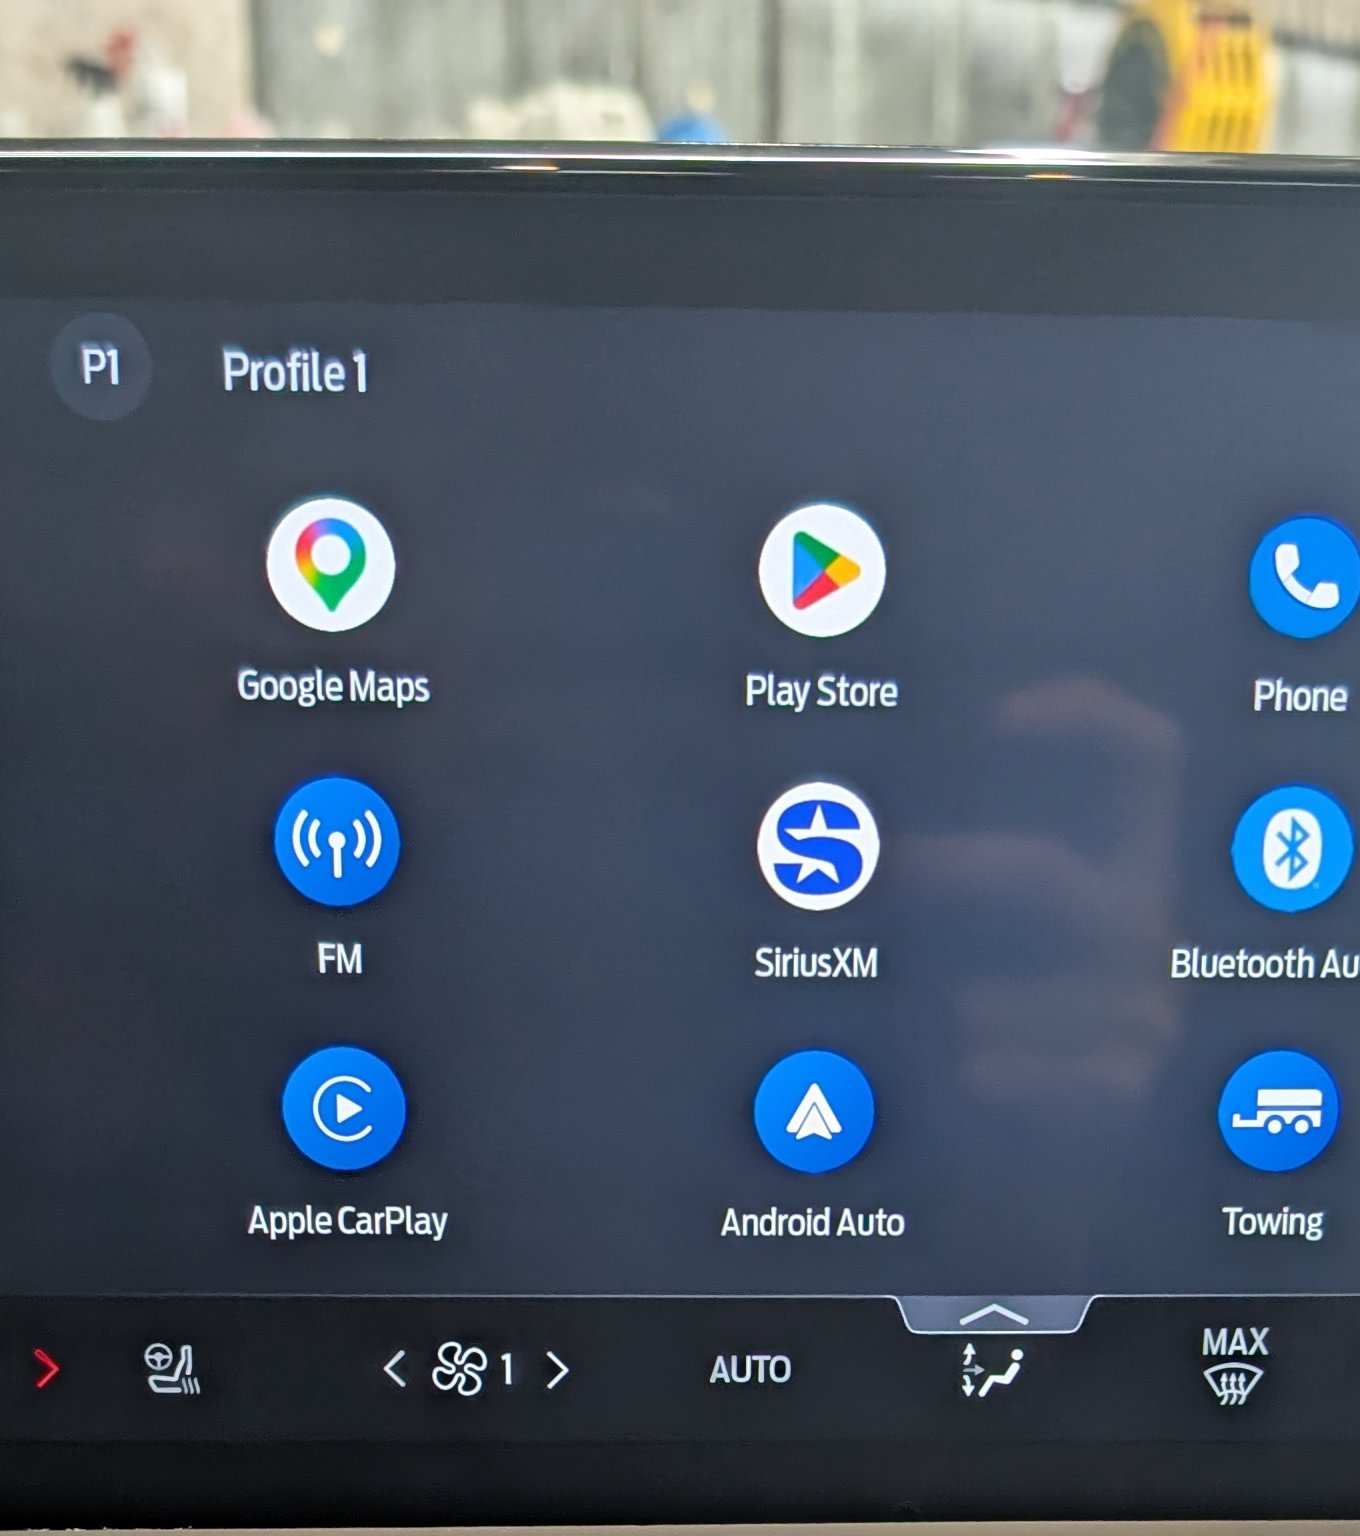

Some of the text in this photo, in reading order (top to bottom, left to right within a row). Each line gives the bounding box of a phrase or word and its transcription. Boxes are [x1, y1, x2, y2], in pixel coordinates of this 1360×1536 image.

[81, 344, 119, 385] P1
[223, 347, 368, 393] Profile 1
[237, 667, 431, 709] Google Maps
[746, 671, 899, 713] Play Store
[1254, 677, 1349, 712] Phone
[318, 941, 363, 974] FM
[754, 946, 878, 978] SiriusXM
[1170, 946, 1315, 979] Bluetooth
[247, 1204, 449, 1242] Apple CarPlay
[720, 1206, 906, 1237] Android Auto
[1221, 1206, 1325, 1242] Towing
[1202, 1326, 1270, 1356] MAX
[500, 1352, 513, 1386] 1
[709, 1354, 792, 1384] AUTO
